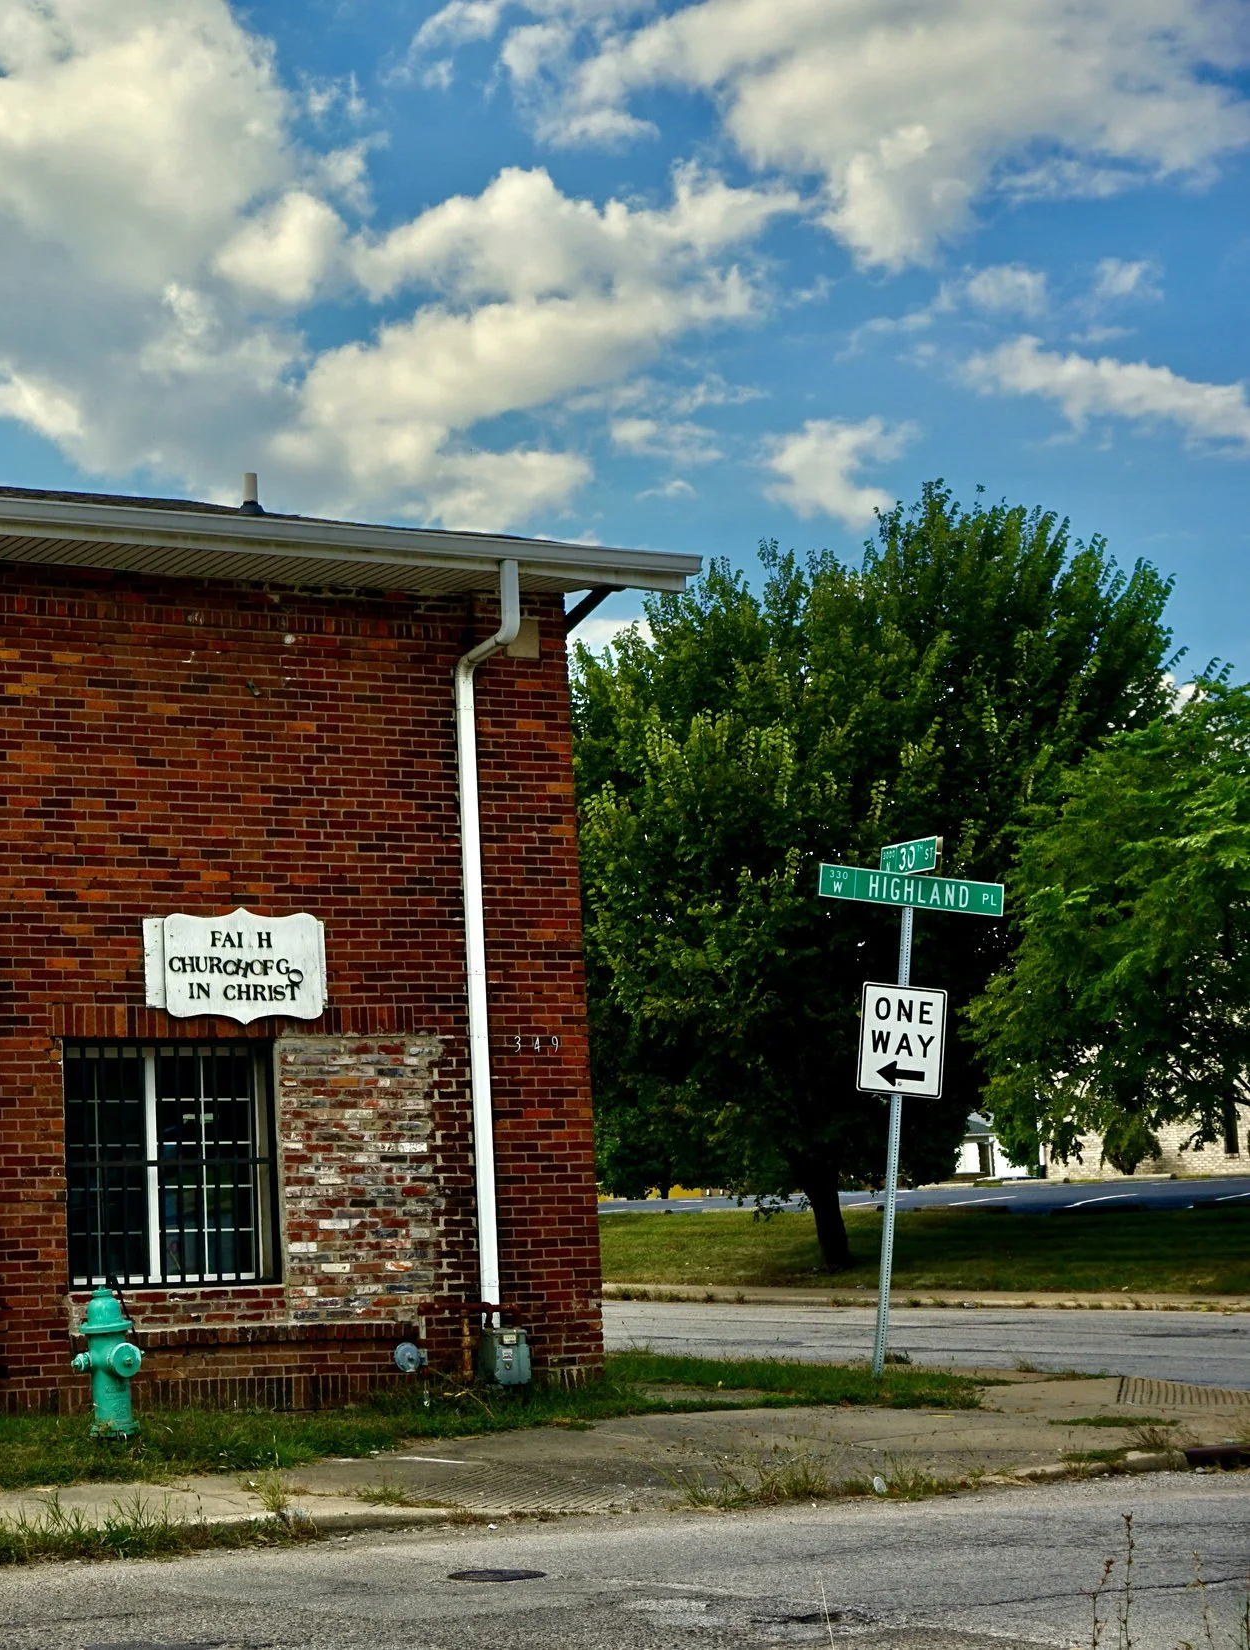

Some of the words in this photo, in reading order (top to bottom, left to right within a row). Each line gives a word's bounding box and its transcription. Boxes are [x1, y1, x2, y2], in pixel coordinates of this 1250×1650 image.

[924, 847, 934, 861] ST
[829, 869, 849, 880] 330
[885, 861, 891, 872] N
[833, 881, 843, 893] W
[868, 874, 969, 908] HIGHLAND
[982, 893, 997, 907] PL
[188, 982, 211, 1000] IN
[223, 983, 301, 1002] CHRIST
[874, 996, 933, 1026] ONE
[514, 1035, 559, 1053] 349
[871, 1029, 935, 1059] WAY
